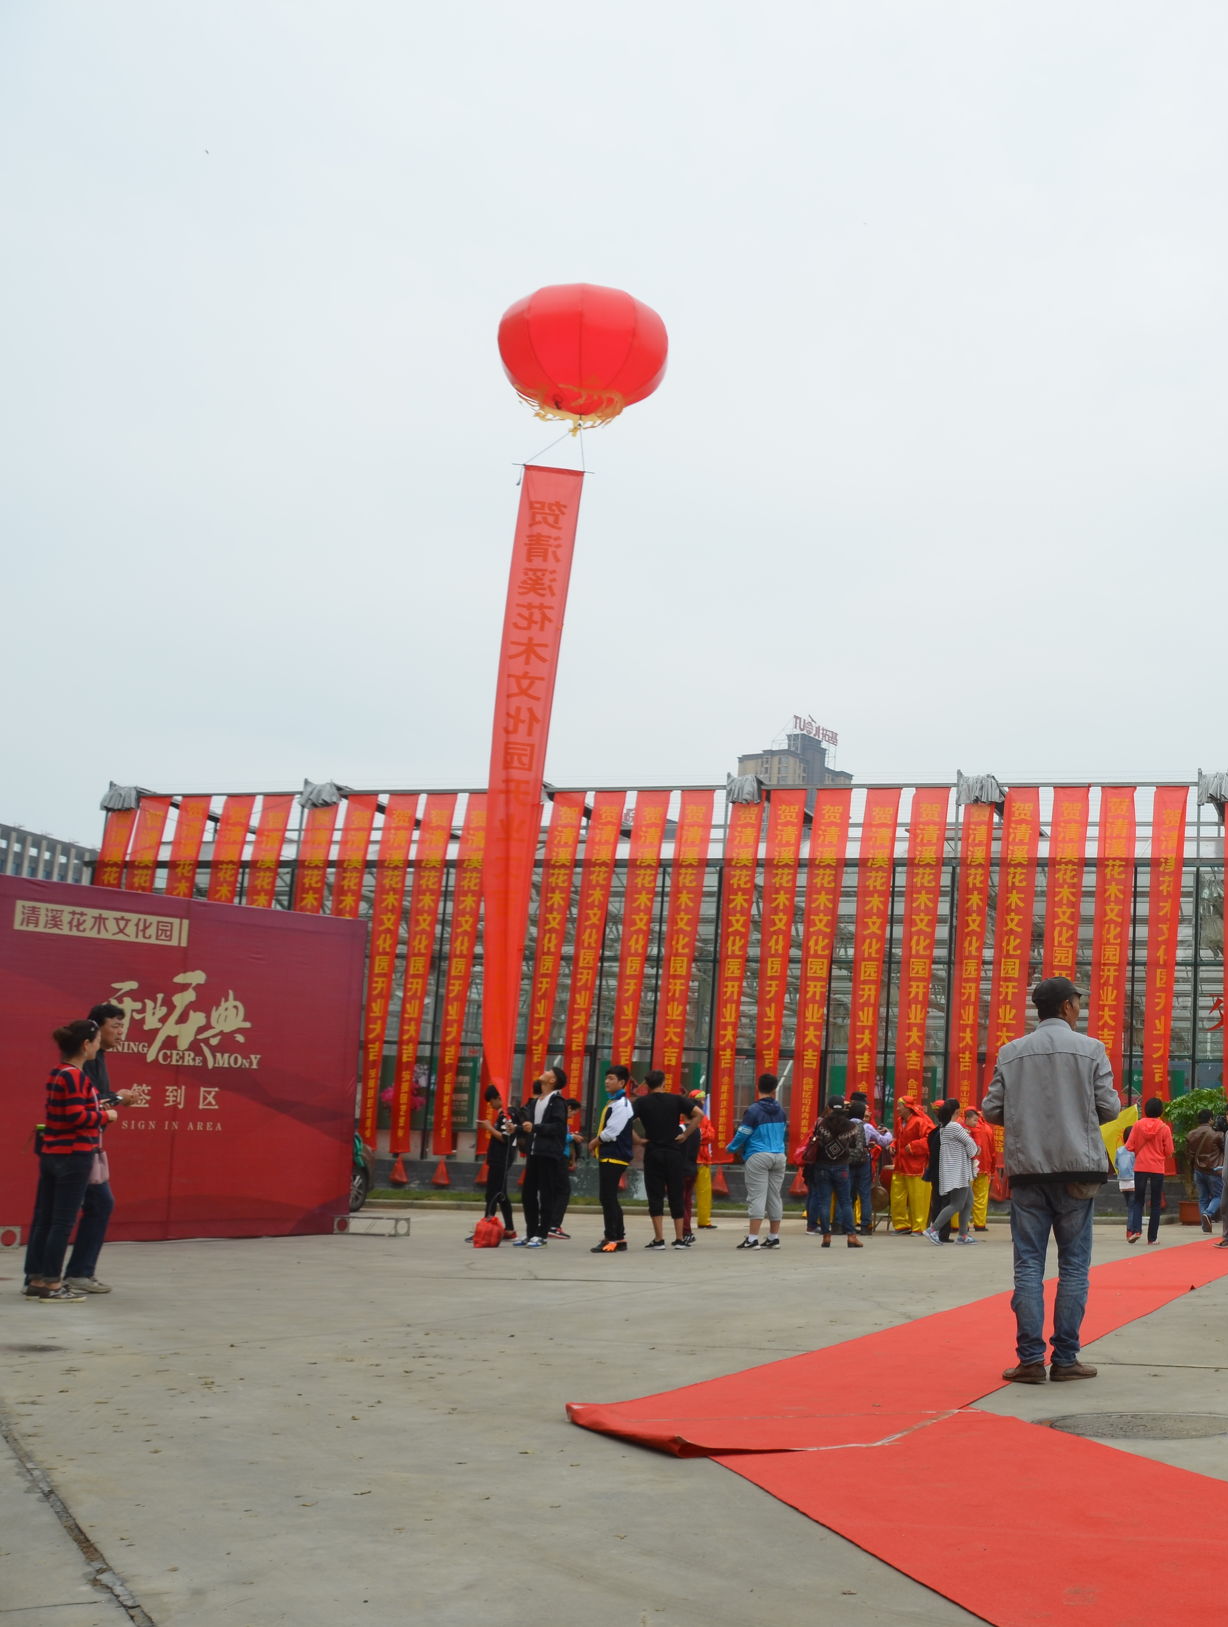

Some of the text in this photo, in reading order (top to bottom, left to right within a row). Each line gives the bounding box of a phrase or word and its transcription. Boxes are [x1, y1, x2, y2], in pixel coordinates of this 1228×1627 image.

[20, 905, 174, 942] 清溪花木文化园
[995, 803, 1033, 1048] 贺清溪花木文化园开业大
[106, 1041, 148, 1053] NING
[130, 1083, 219, 1109] 签到区
[121, 1120, 222, 1131] SIGN IN AREA
